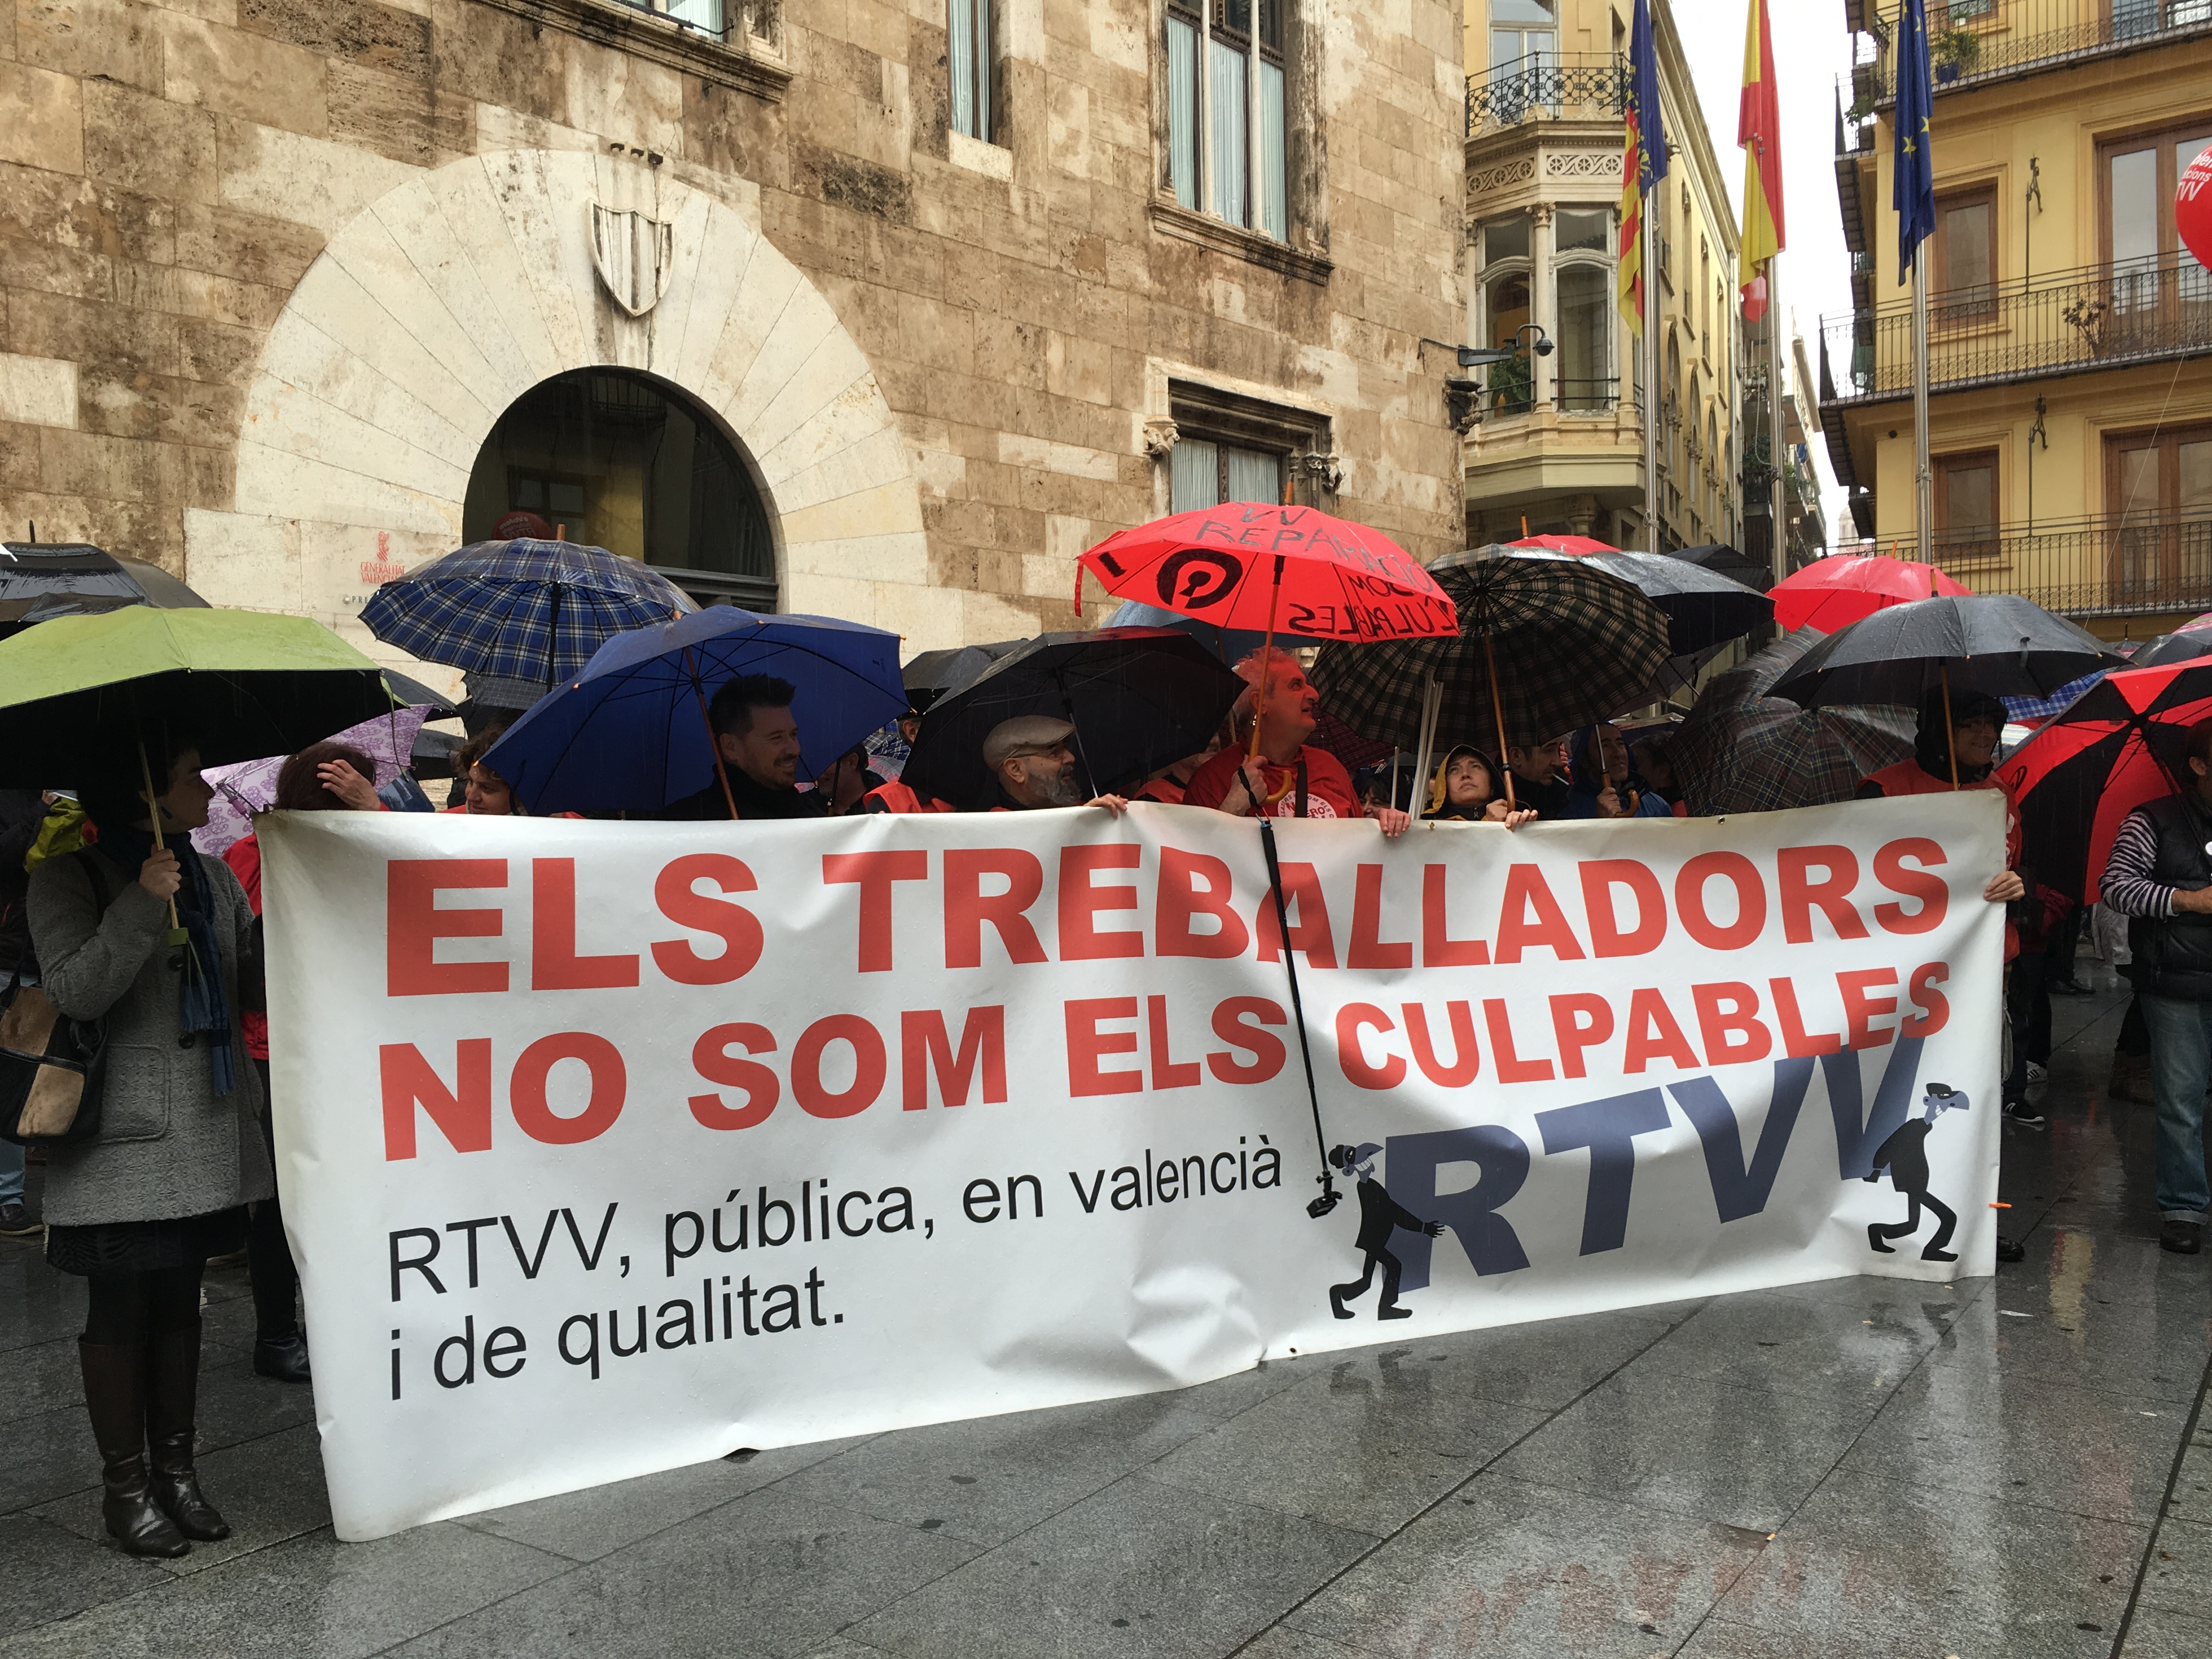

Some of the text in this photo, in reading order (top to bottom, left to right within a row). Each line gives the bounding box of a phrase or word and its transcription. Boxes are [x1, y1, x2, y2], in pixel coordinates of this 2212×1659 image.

[360, 561, 405, 575] GENERALITAT
[387, 853, 764, 997] ELS
[822, 838, 1948, 973] TREBALLADORS
[379, 962, 1949, 1161] NO SOM ELS CULPABLES
[389, 1133, 1281, 1302] RTVV, pública, en valencià
[1384, 1017, 1927, 1296] RTVV
[391, 1266, 843, 1401] i de qualitat.
